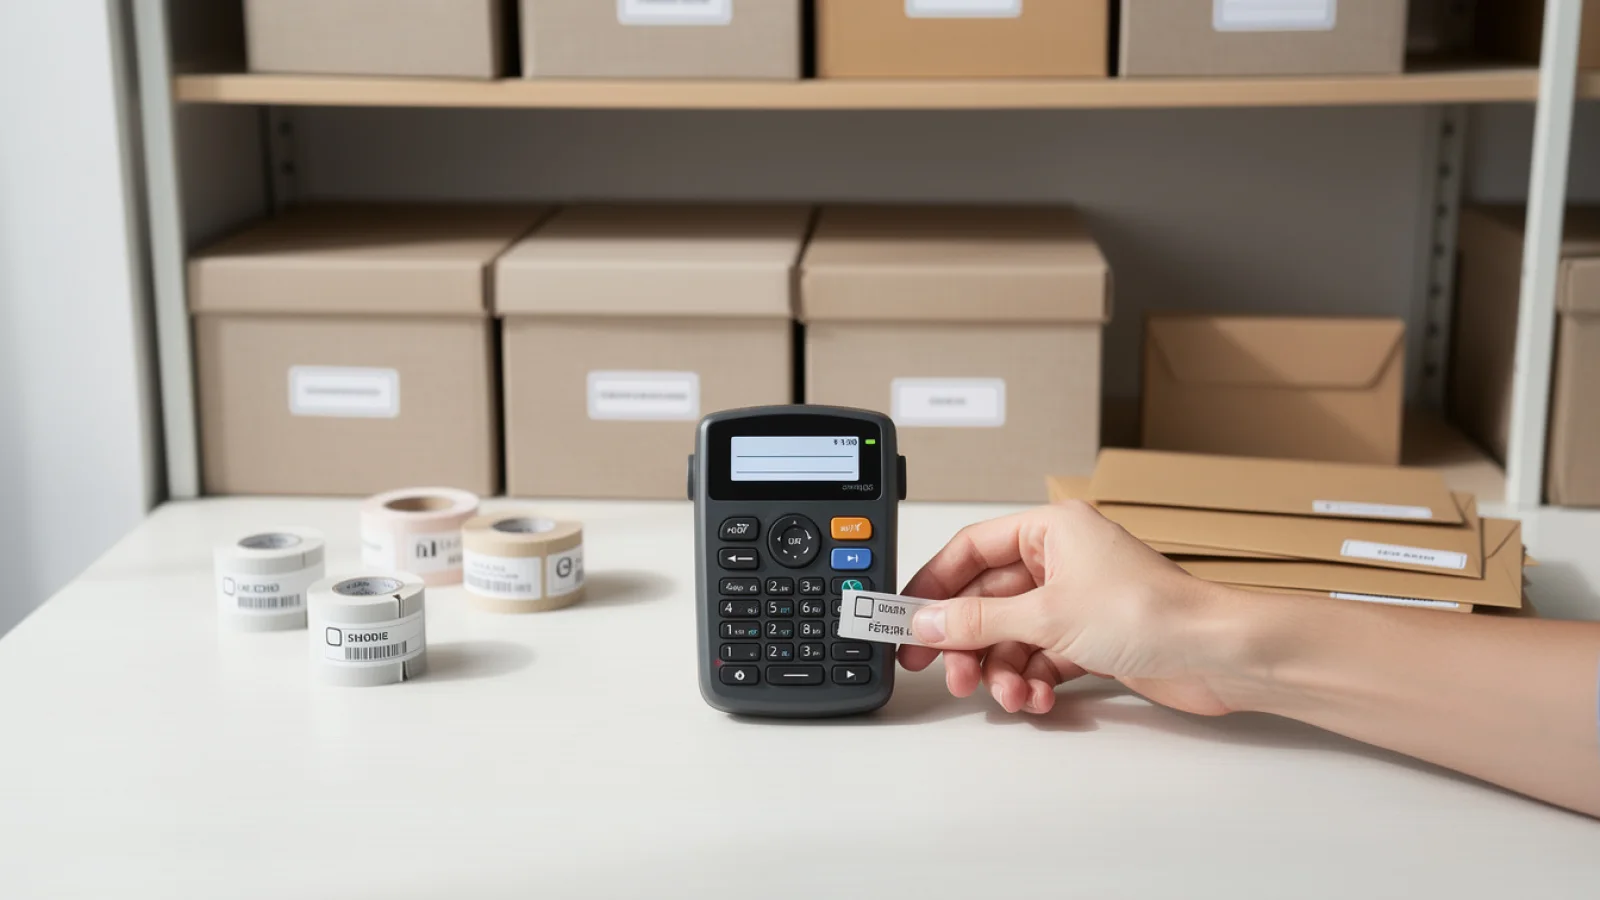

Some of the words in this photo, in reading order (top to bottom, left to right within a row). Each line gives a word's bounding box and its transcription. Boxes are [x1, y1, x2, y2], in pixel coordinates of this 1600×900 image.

[769, 580, 777, 591] 2
[802, 580, 810, 592] 3
[769, 601, 777, 613] 5
[802, 602, 810, 613] 6
[769, 623, 777, 634] 2
[347, 631, 389, 643] SHODIE
[769, 646, 777, 657] 2
[803, 645, 811, 657] 3
